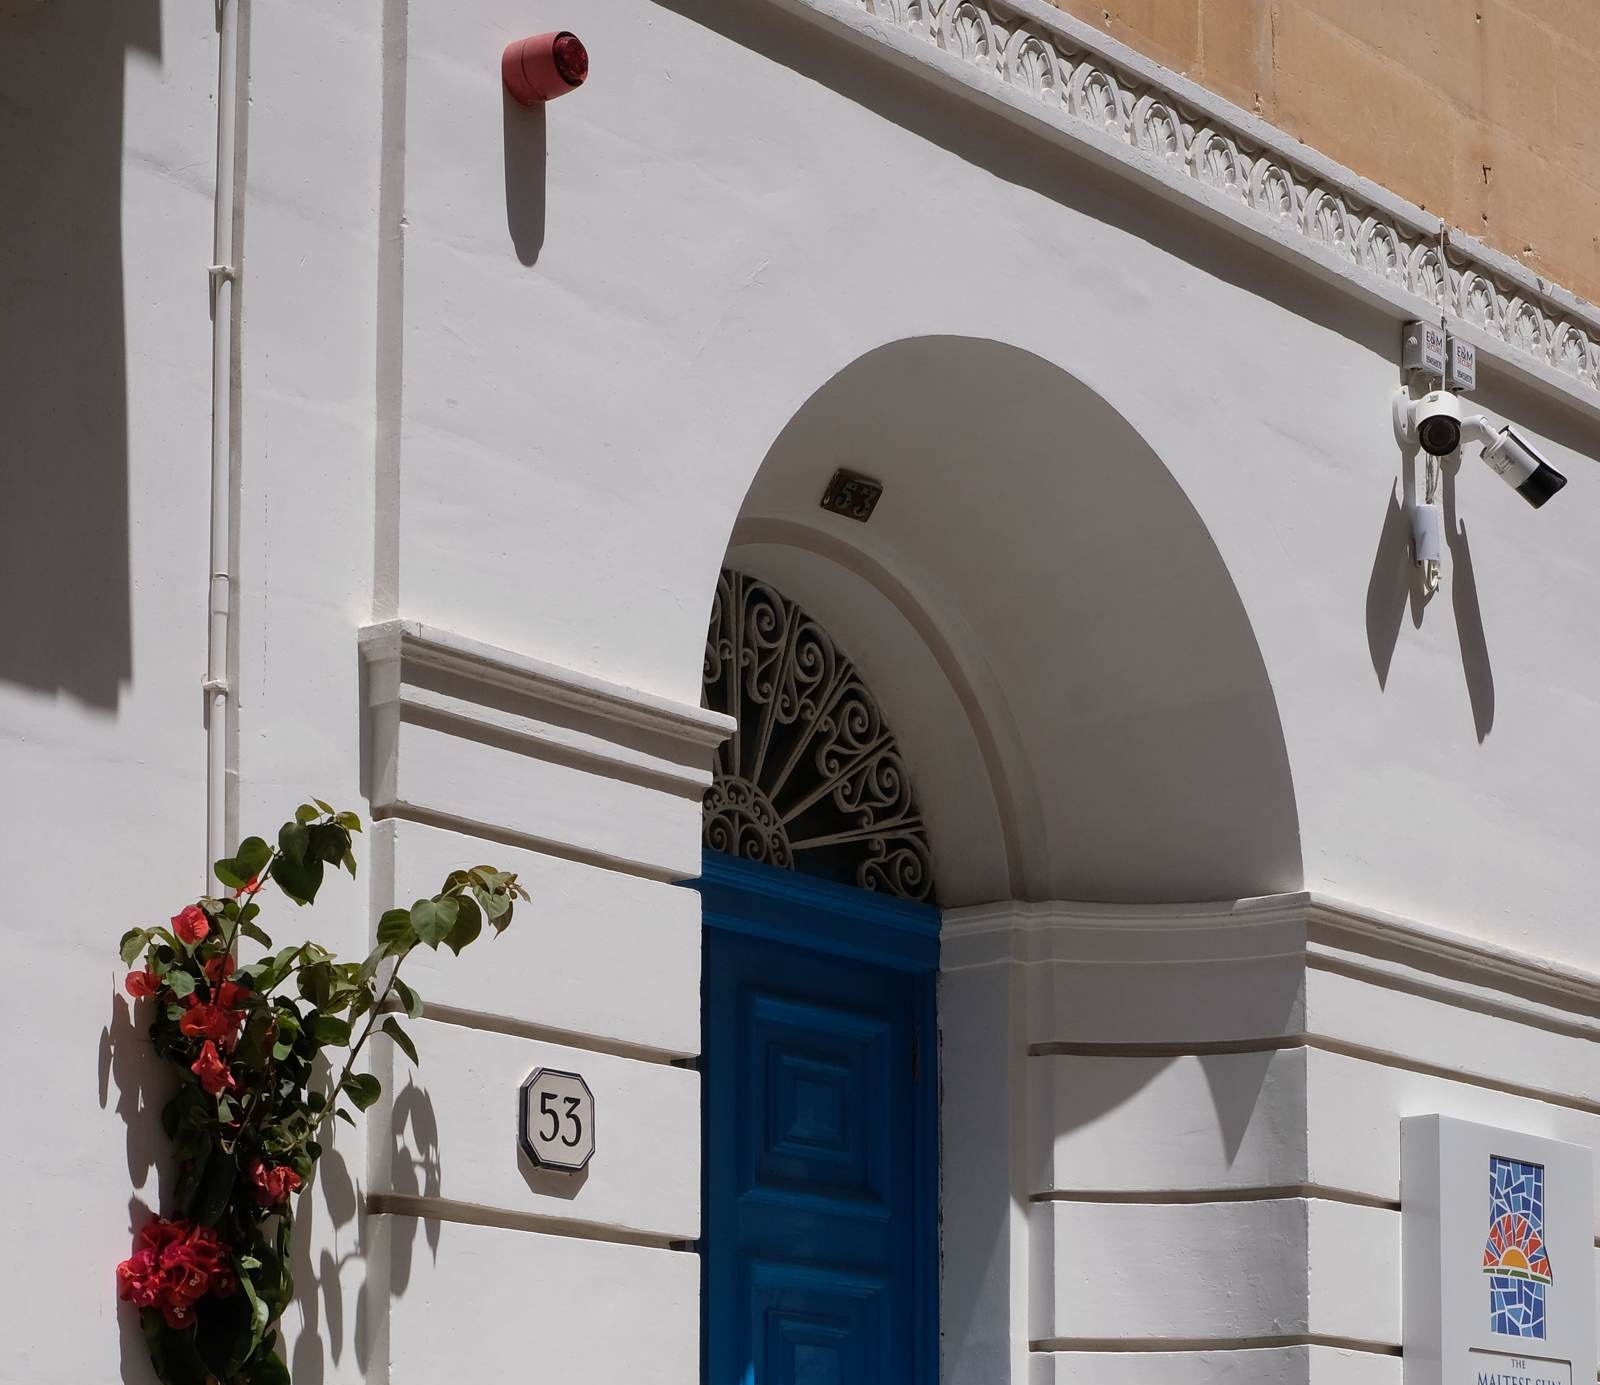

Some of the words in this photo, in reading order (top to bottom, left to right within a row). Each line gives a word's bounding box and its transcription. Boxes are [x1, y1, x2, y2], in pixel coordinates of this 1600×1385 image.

[834, 480, 881, 517] 53
[539, 1091, 582, 1147] 53
[1511, 1359, 1527, 1369] THE
